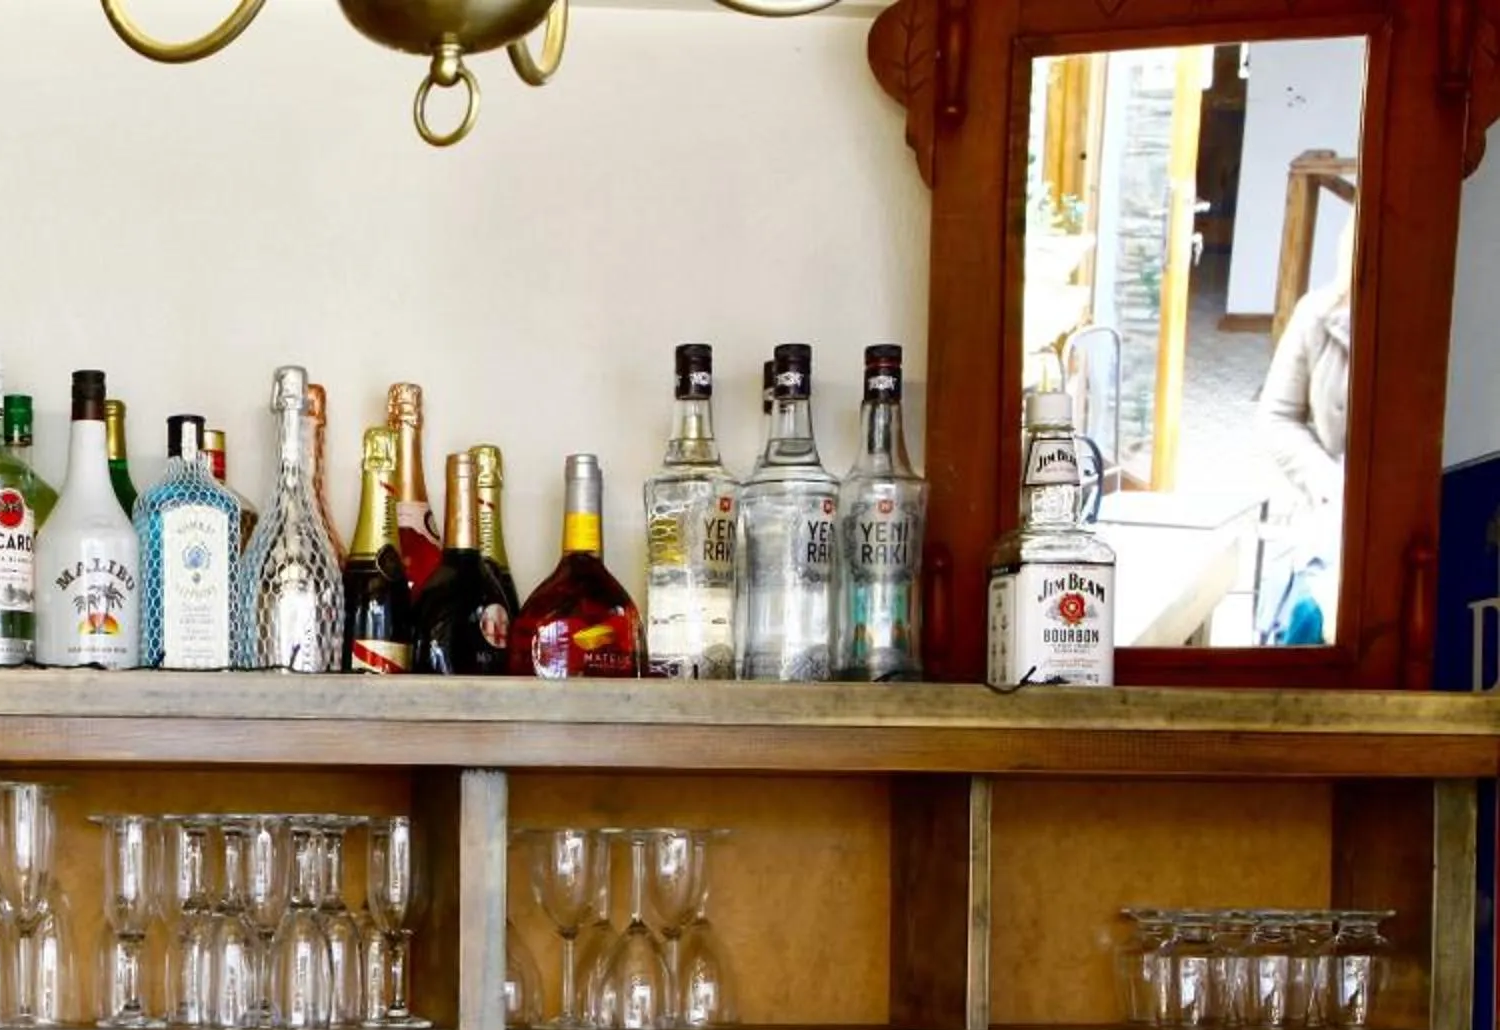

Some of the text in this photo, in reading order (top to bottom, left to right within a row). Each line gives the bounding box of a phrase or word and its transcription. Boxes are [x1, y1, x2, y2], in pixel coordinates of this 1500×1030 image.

[704, 518, 737, 540] YEN
[861, 543, 907, 565] RAKI
[55, 558, 136, 591] MALIBU
[1038, 573, 1106, 603] JIM BEAM
[1043, 628, 1100, 643] BOURBON
